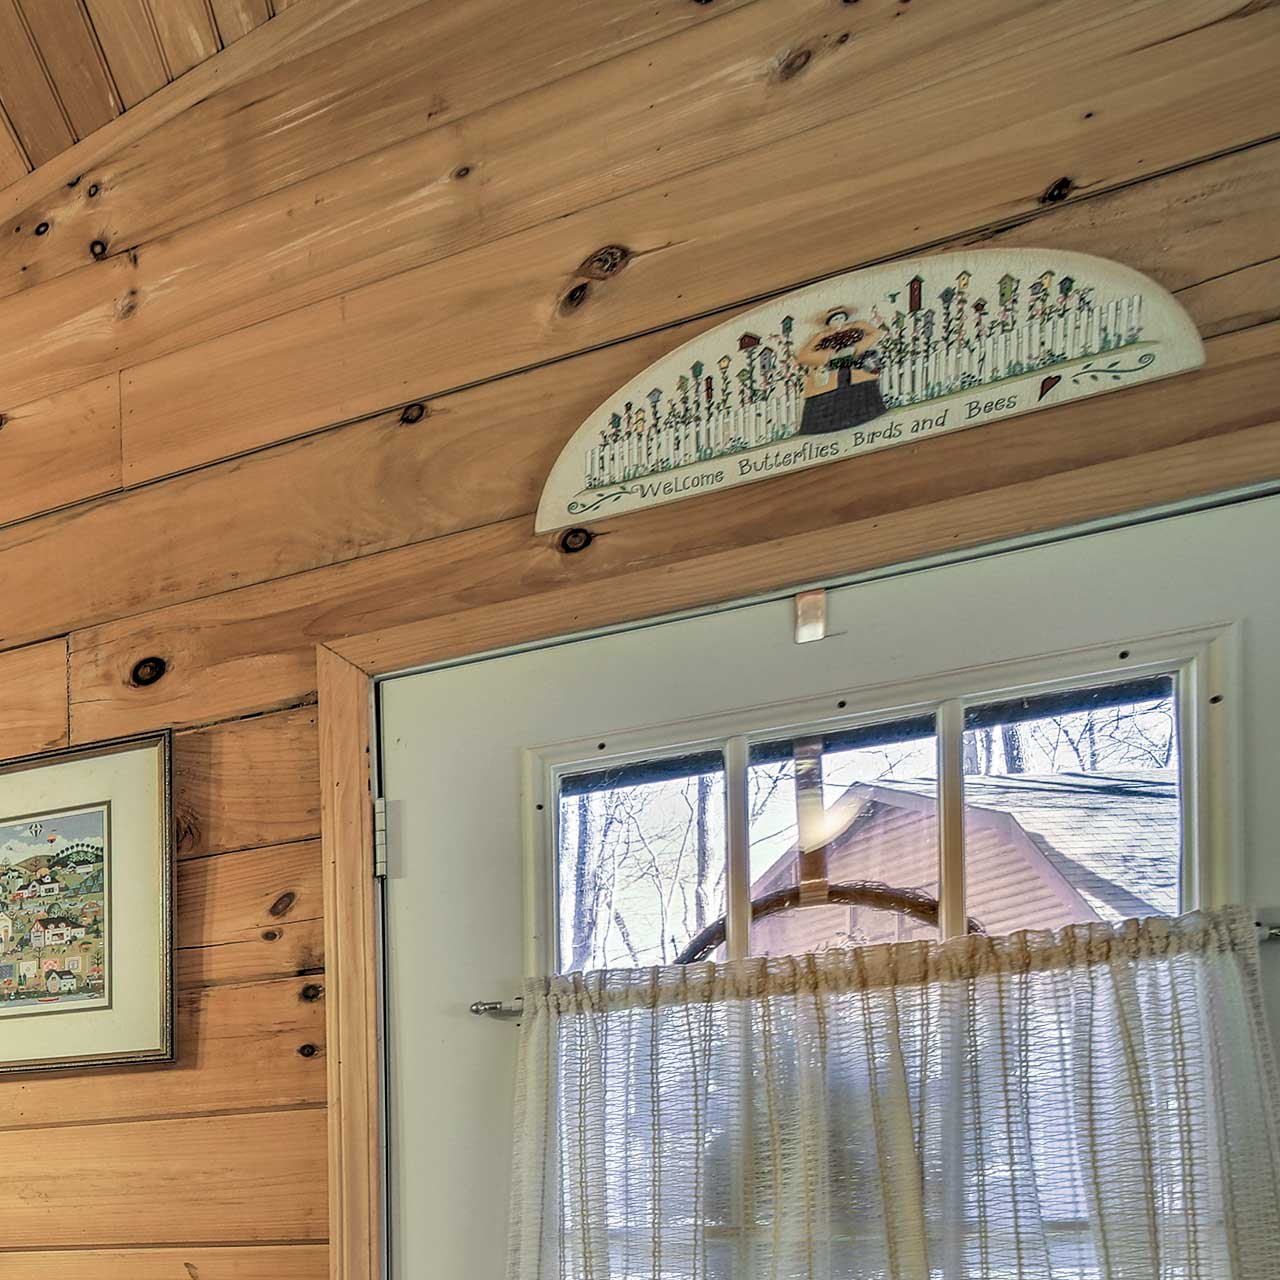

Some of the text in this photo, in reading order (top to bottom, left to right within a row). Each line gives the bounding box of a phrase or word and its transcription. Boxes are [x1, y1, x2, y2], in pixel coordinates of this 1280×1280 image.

[636, 469, 725, 499] Welcome
[853, 421, 903, 448] Birds
[910, 408, 949, 434] and
[965, 394, 1018, 421] Bees
